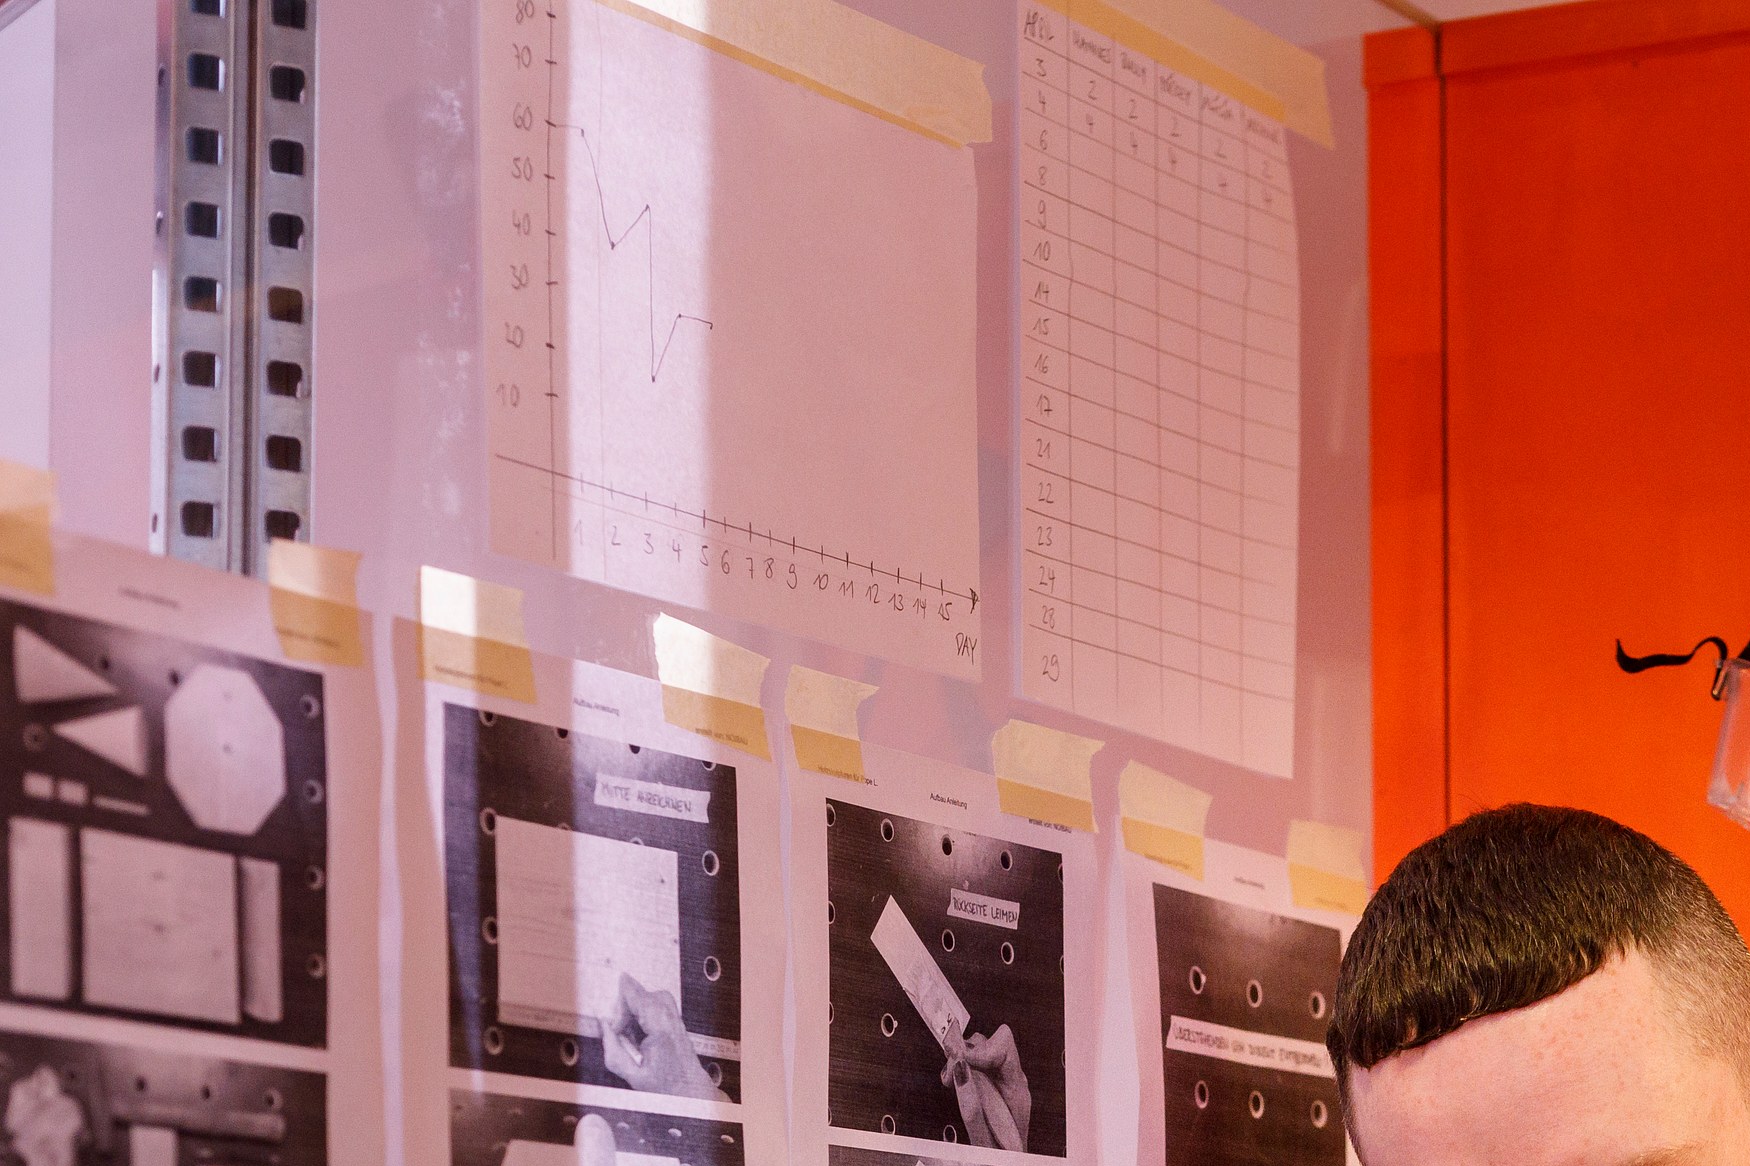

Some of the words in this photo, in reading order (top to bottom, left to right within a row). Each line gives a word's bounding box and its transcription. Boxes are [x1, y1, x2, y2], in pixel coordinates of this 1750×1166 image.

[512, 43, 532, 69] 70
[1036, 58, 1047, 77] 3
[1038, 90, 1047, 114] 4
[513, 105, 533, 131] 60
[1039, 130, 1048, 151] 6
[512, 157, 534, 182] 50
[1038, 166, 1048, 187] 8
[512, 209, 531, 236] 40
[1038, 200, 1047, 230] 9
[1034, 241, 1050, 262] 10
[510, 263, 529, 290] 30
[1034, 281, 1050, 300] 14
[1033, 318, 1050, 336] 15
[1034, 353, 1049, 374] 16
[1036, 393, 1053, 418] 17
[1036, 438, 1051, 458] 21
[1038, 482, 1055, 504] 22
[1037, 526, 1053, 547] 23
[575, 520, 584, 546] 1
[610, 525, 621, 546] 2
[644, 533, 653, 554] 3
[671, 539, 682, 562] 4
[700, 544, 709, 567] 5
[721, 551, 730, 575] 6
[746, 556, 755, 579] 7
[765, 557, 774, 579] 8
[788, 563, 798, 589] 9
[813, 573, 829, 591] 10
[839, 579, 855, 598] 11
[865, 583, 880, 604] 12
[888, 594, 904, 611] 13
[913, 597, 928, 618] 14
[937, 602, 953, 621] 15
[1039, 565, 1056, 594] 24
[956, 632, 979, 661] DAY
[1042, 655, 1060, 682] 29
[990, 906, 1018, 923] LEIMEN
